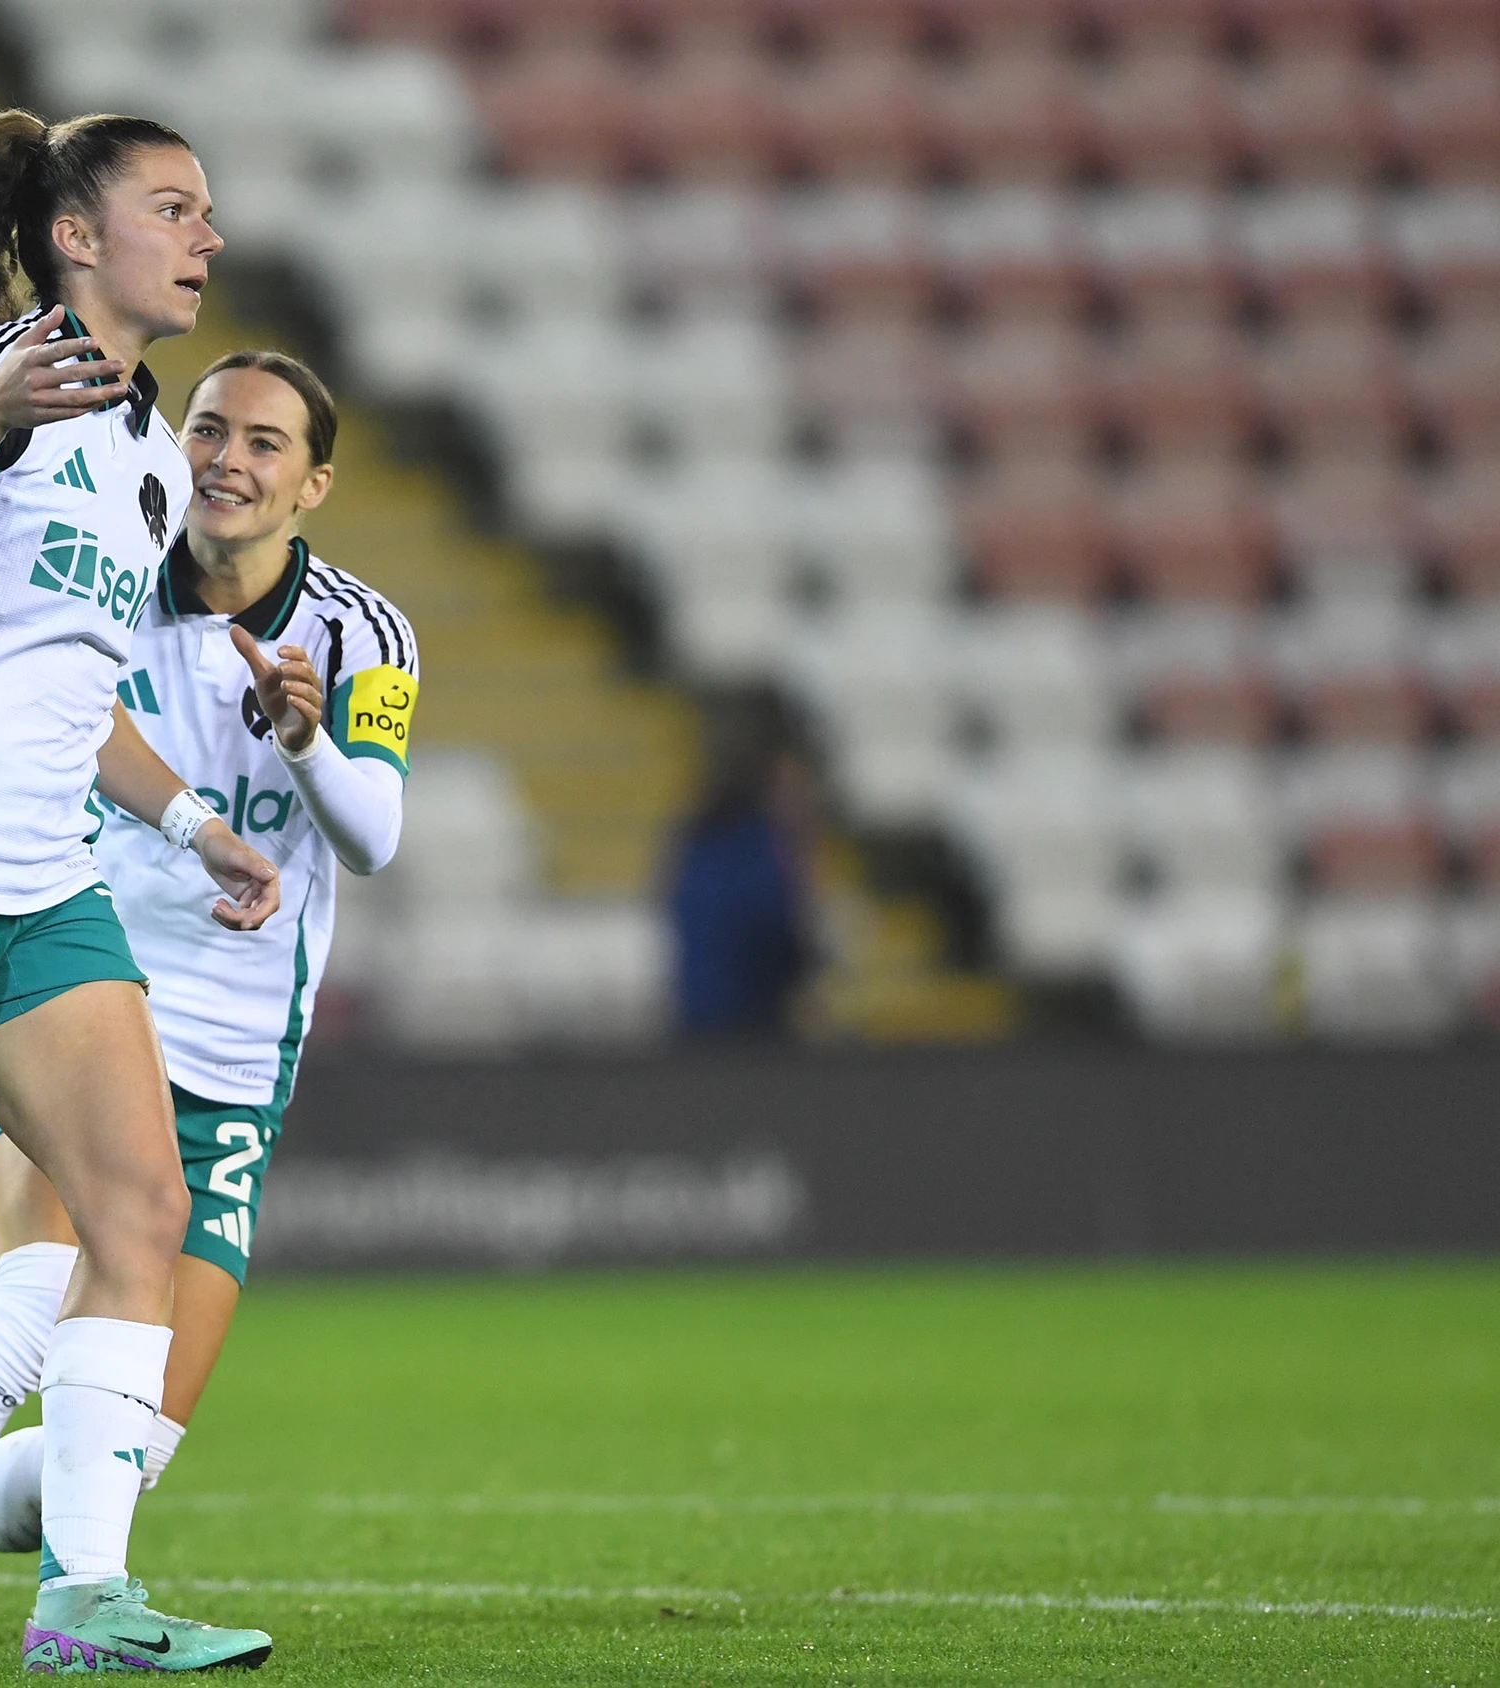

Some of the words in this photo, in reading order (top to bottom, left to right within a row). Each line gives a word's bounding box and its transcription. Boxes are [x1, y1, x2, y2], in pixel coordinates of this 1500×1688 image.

[356, 711, 406, 741] noo
[193, 774, 294, 836] ela
[208, 1121, 272, 1204] 2
